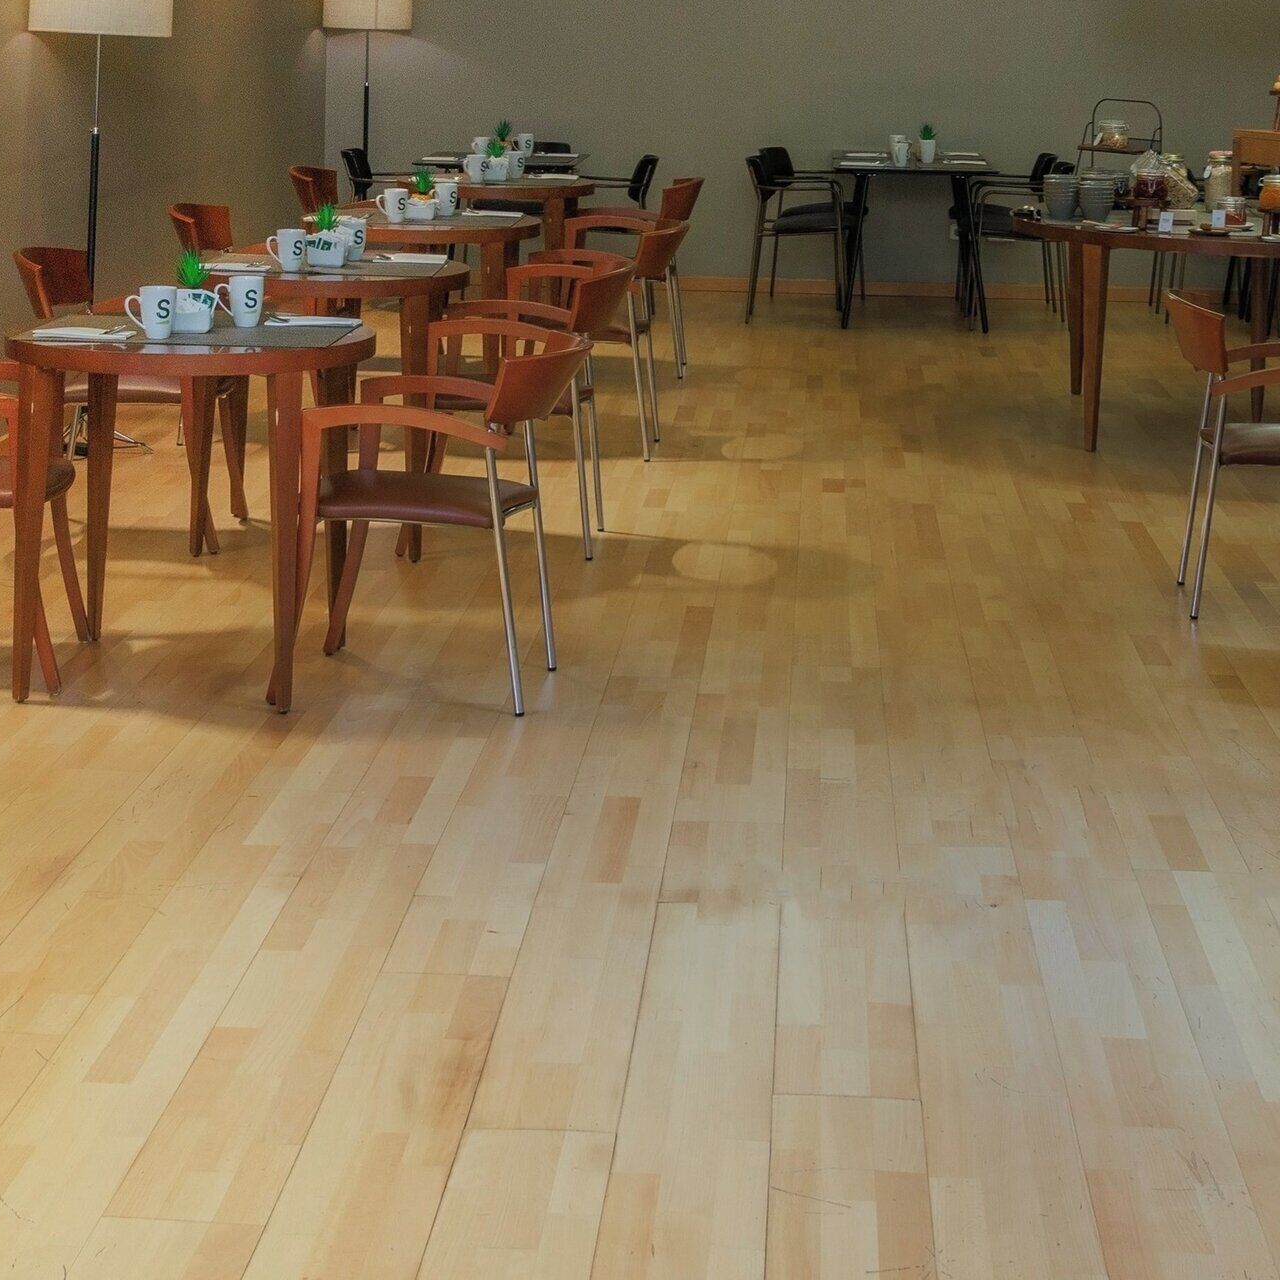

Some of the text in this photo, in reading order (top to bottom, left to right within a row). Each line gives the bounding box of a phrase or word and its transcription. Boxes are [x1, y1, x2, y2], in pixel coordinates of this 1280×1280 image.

[397, 197, 406, 211] S
[354, 229, 364, 245] S
[292, 240, 303, 256] S
[245, 289, 258, 308] S
[156, 299, 170, 319] S
